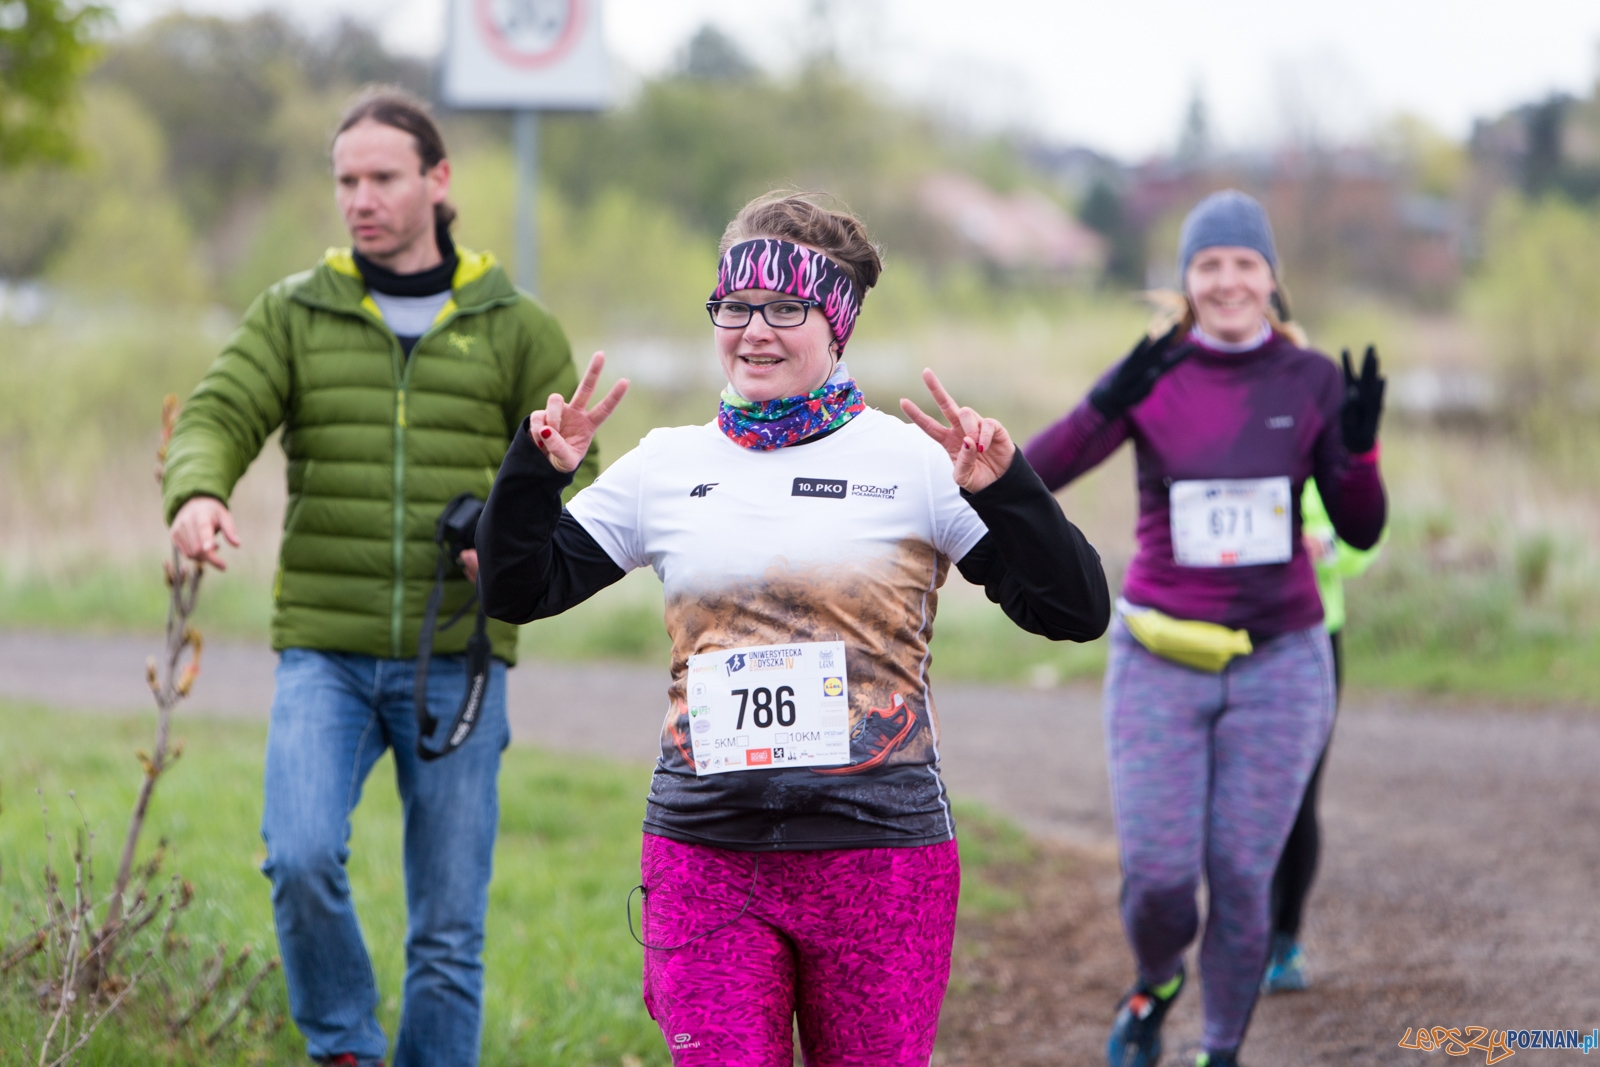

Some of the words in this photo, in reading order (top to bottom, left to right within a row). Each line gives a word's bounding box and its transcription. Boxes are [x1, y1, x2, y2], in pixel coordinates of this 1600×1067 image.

[798, 482, 814, 493] 10.
[816, 483, 844, 495] PKO
[1210, 508, 1253, 538] 671
[748, 648, 802, 659] UNIWERSYTECKA
[749, 657, 784, 668] ZADYSZKA
[785, 657, 794, 669] IV
[731, 685, 796, 730] 786
[714, 737, 736, 749] 5KM
[789, 731, 821, 742] 10KM
